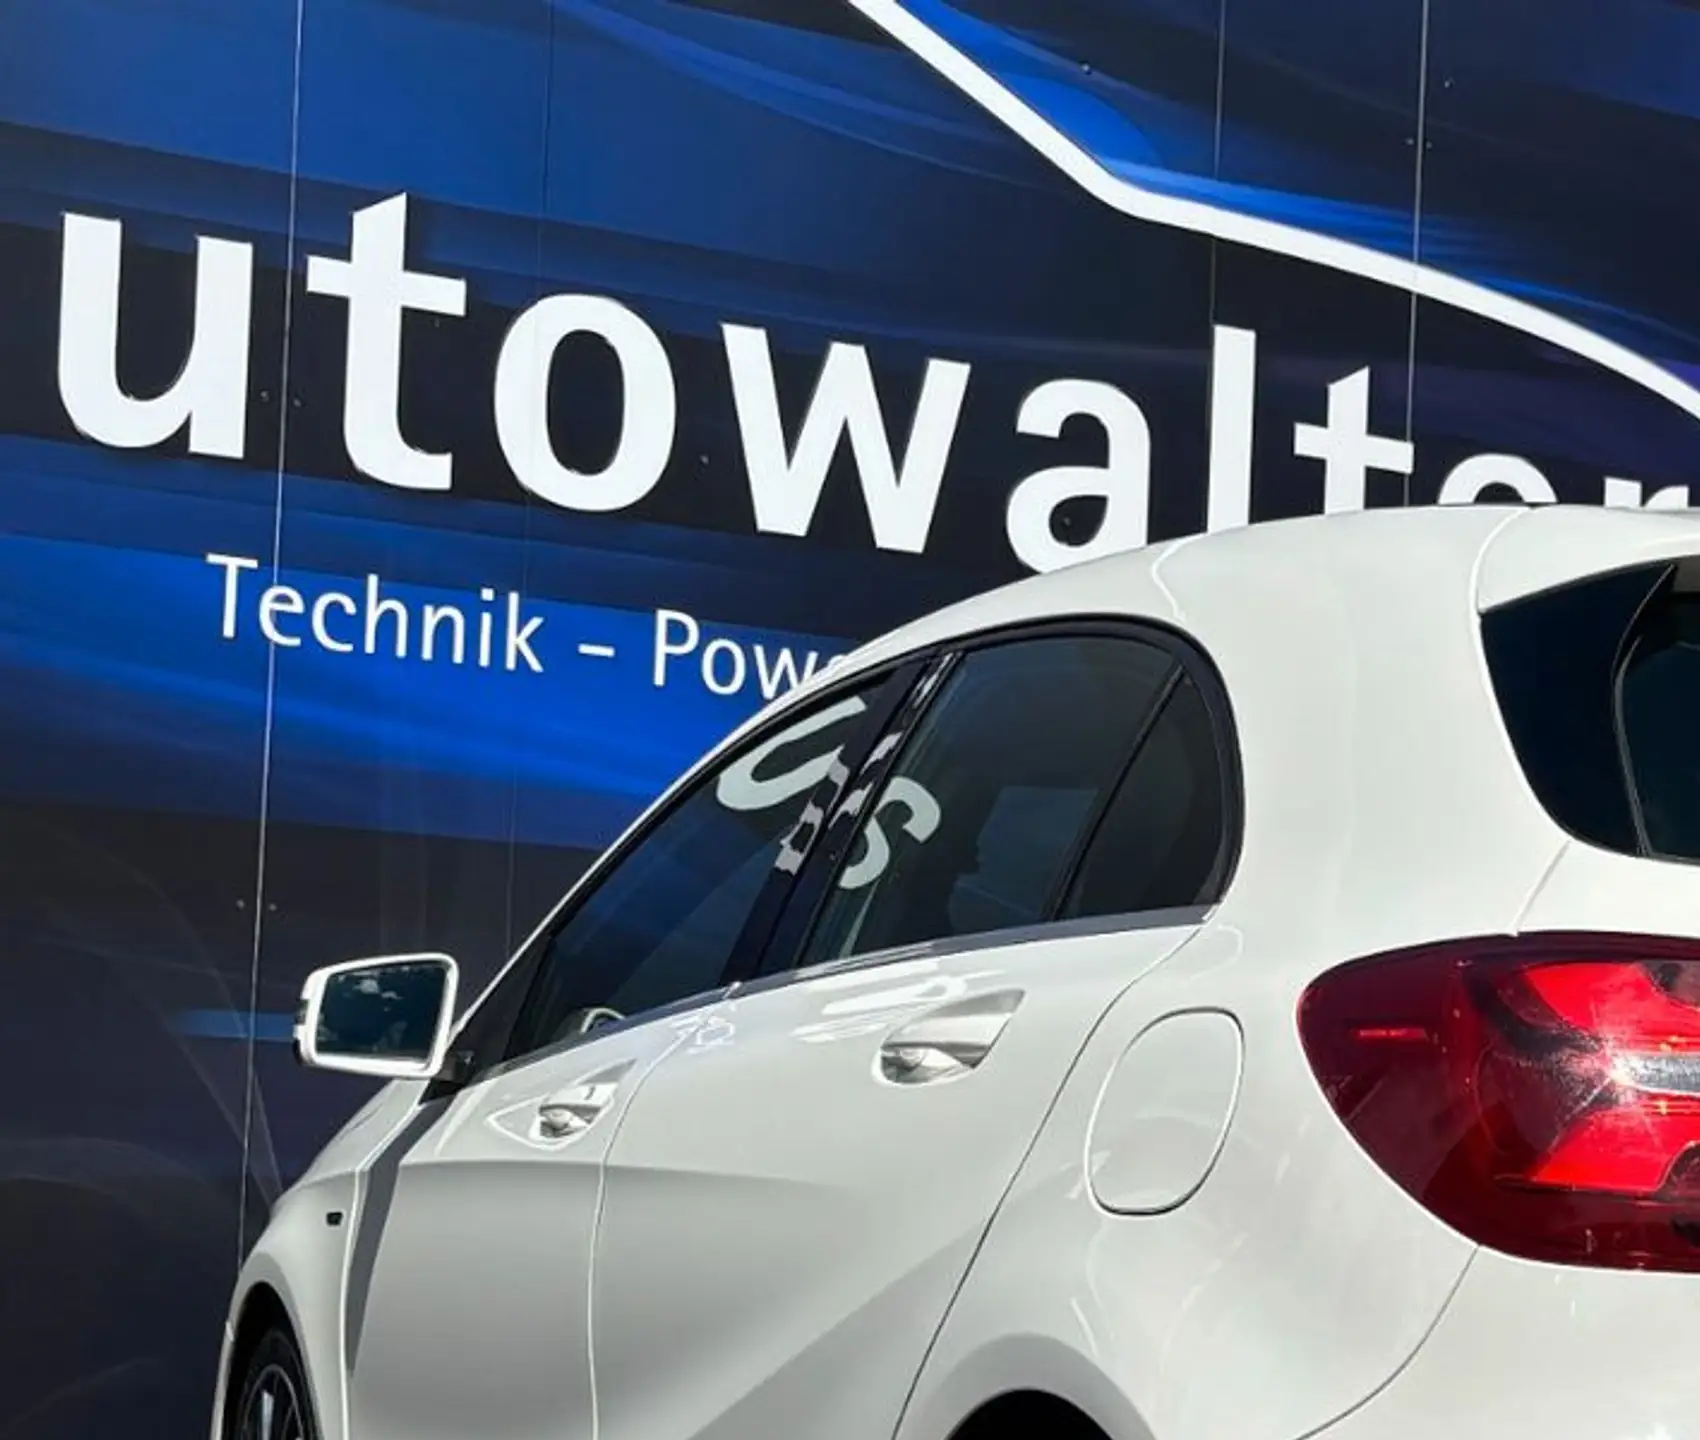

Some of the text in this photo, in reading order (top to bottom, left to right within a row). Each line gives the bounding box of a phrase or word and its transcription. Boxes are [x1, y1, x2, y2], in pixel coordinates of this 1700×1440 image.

[58, 192, 1690, 575] utowalt
[206, 553, 544, 673] Technik
[654, 609, 853, 702] Pow
